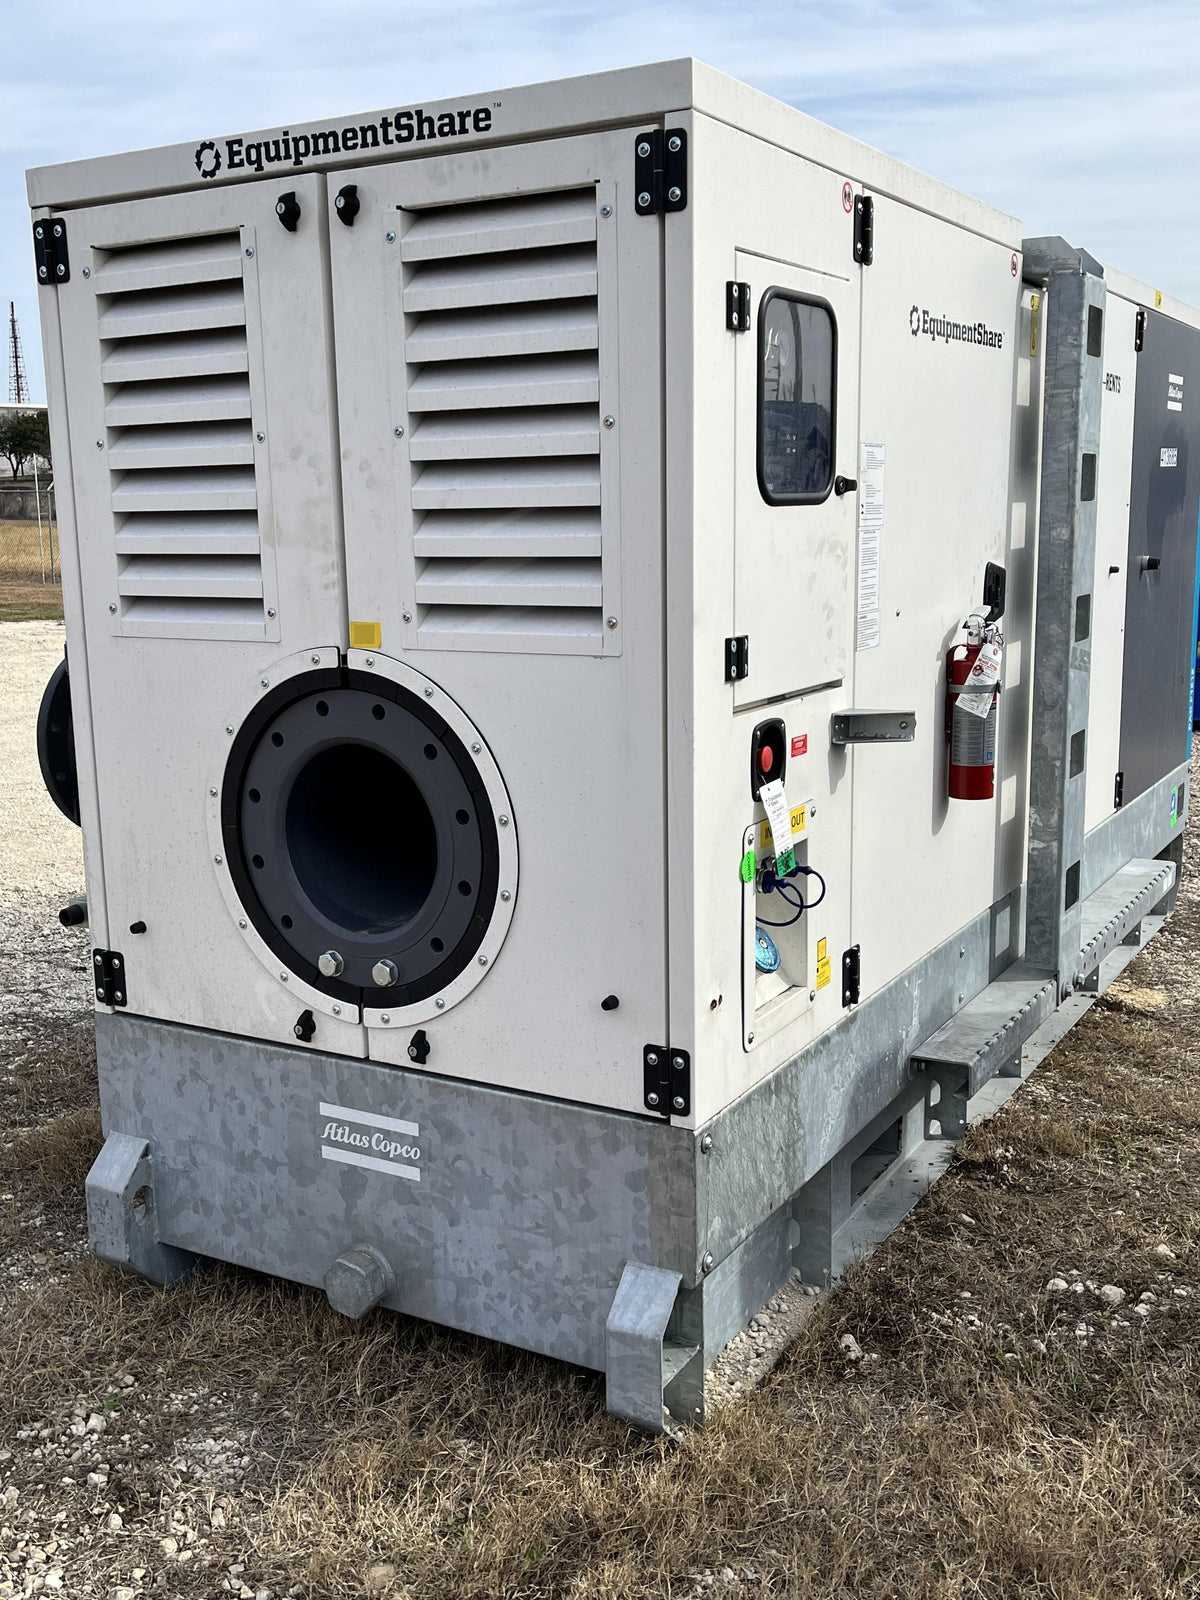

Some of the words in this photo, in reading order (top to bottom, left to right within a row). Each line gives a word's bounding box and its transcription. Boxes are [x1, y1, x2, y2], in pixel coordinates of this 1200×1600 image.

[225, 107, 492, 172] EquipmentShare
[921, 309, 1003, 349] EquipmentShare
[791, 811, 805, 828] OUT
[320, 1122, 370, 1148] Atlas
[371, 1132, 421, 1160] Copco
